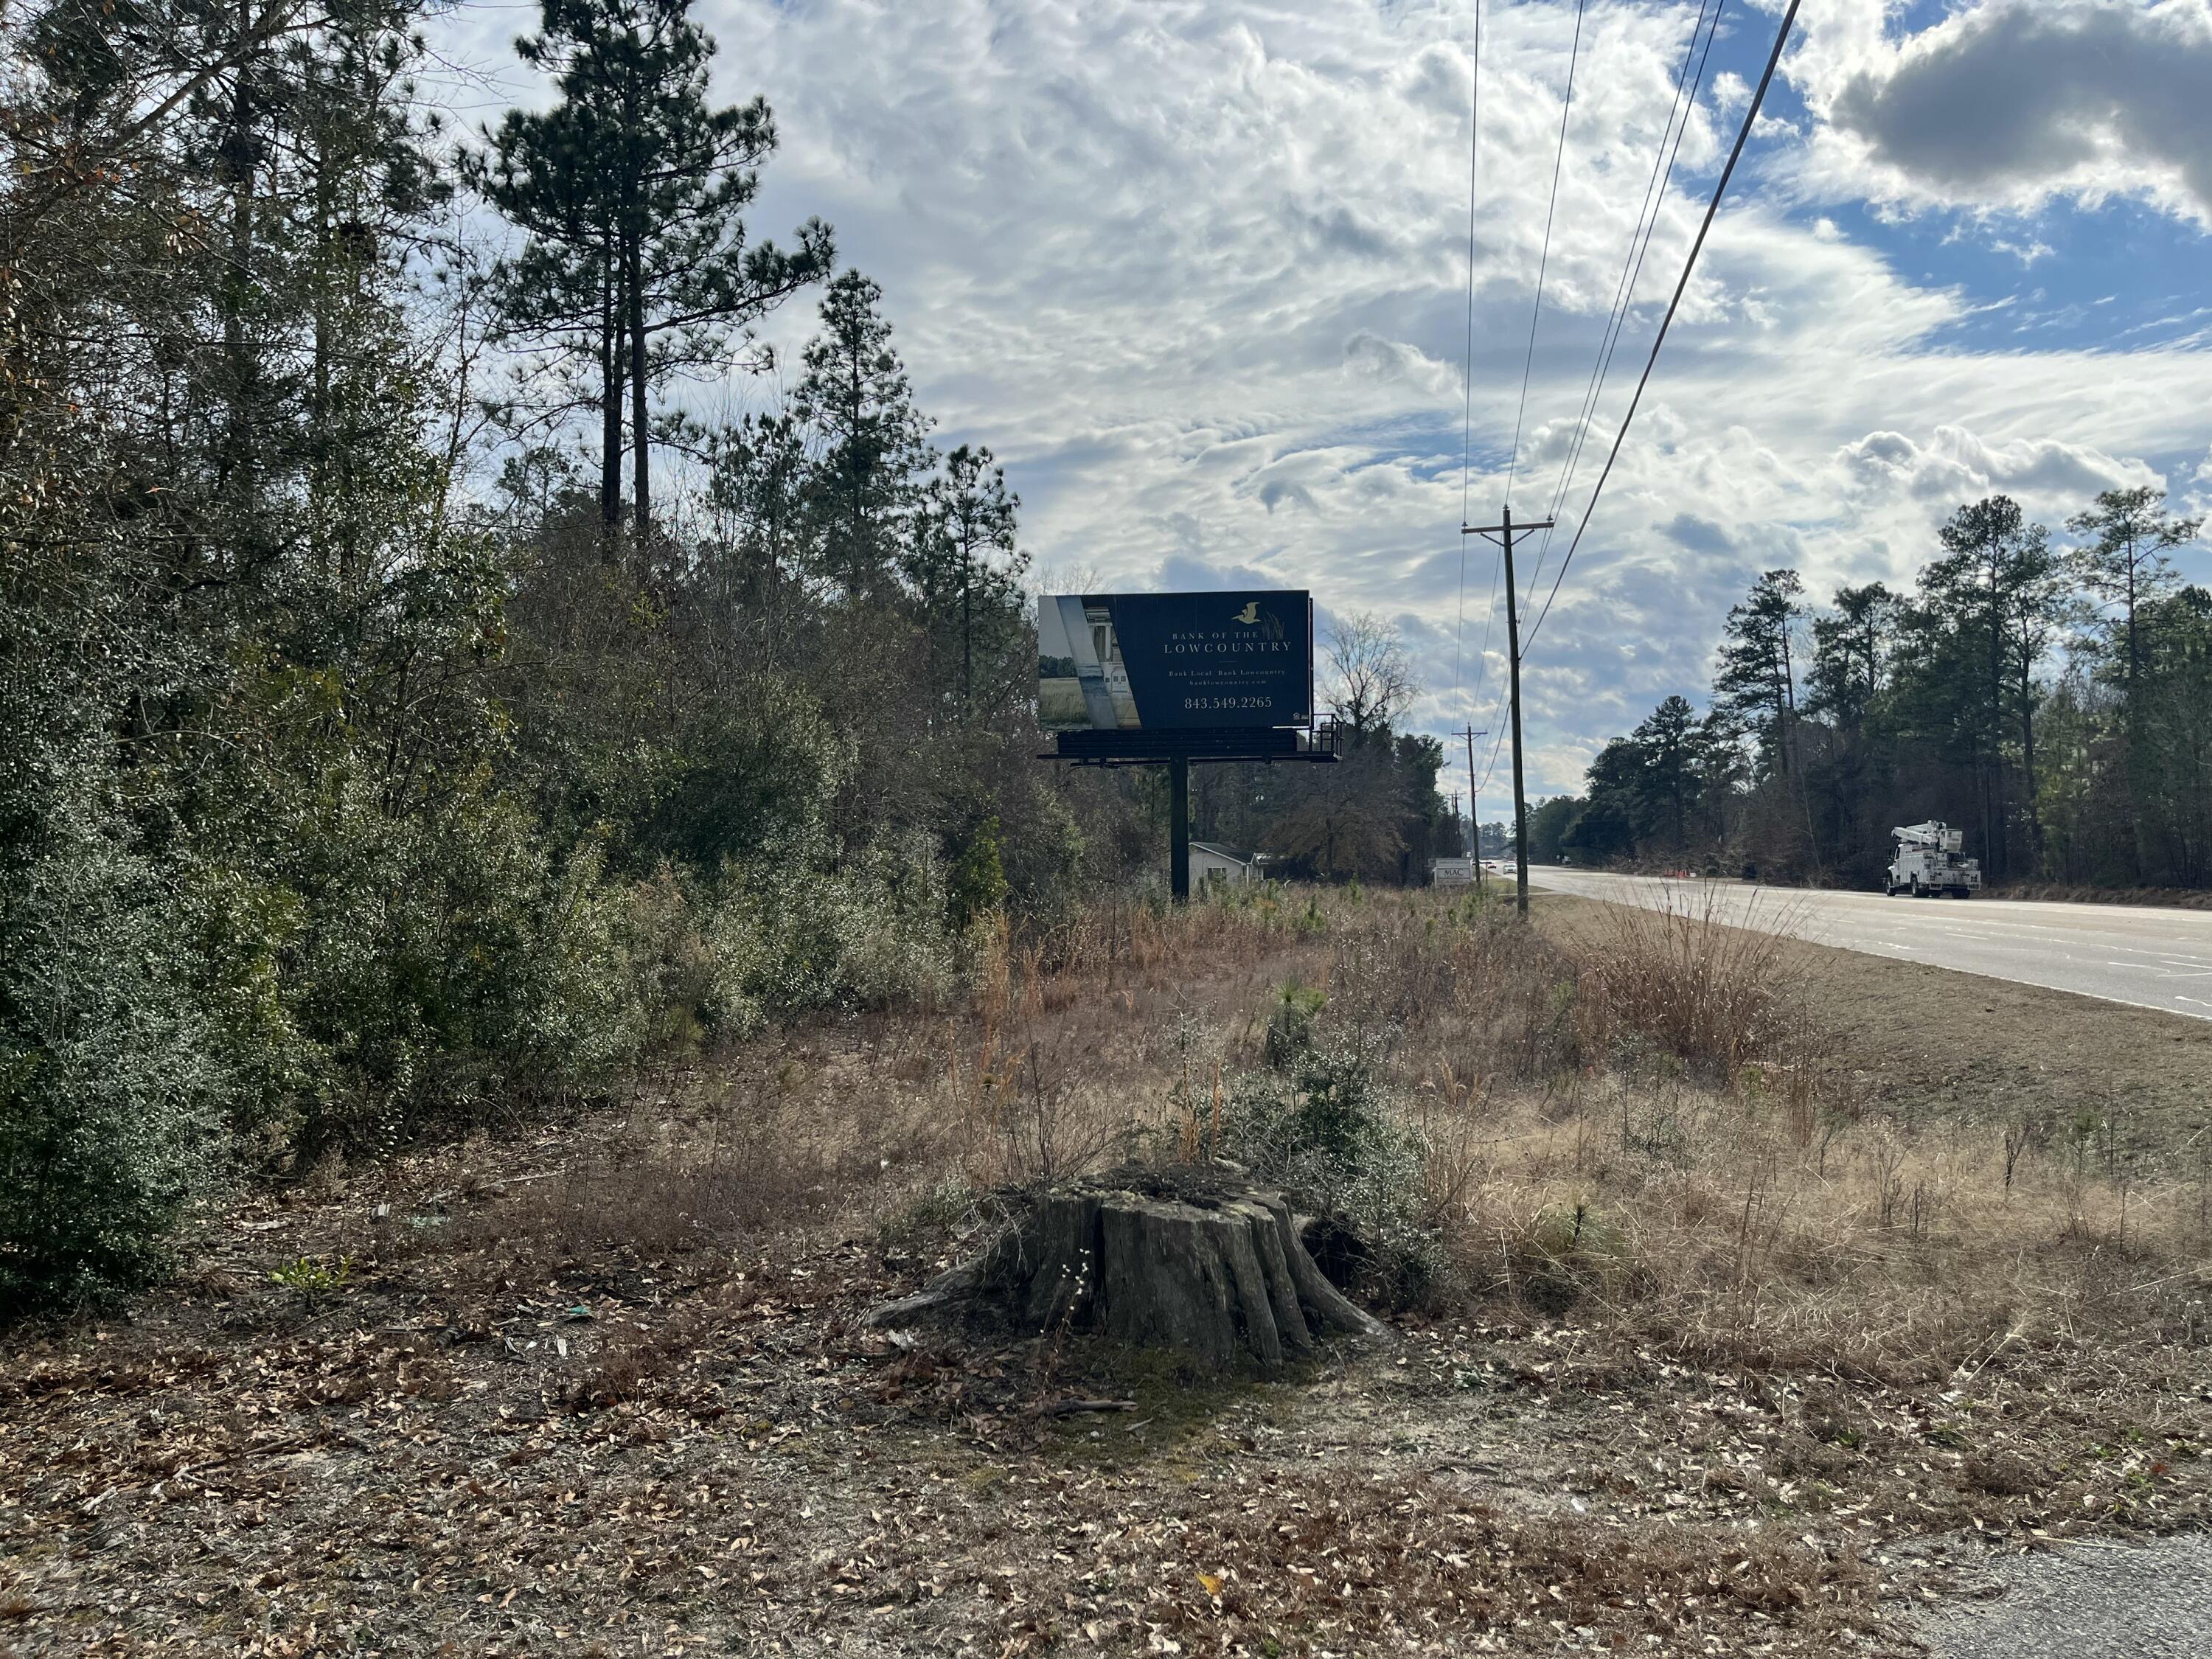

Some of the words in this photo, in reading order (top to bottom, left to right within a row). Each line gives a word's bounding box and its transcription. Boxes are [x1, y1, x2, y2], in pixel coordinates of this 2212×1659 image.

[1172, 632, 1204, 640] BANK
[1164, 641, 1292, 653] LOWCOUNTRY
[1185, 697, 1272, 709] 843.549.2265
